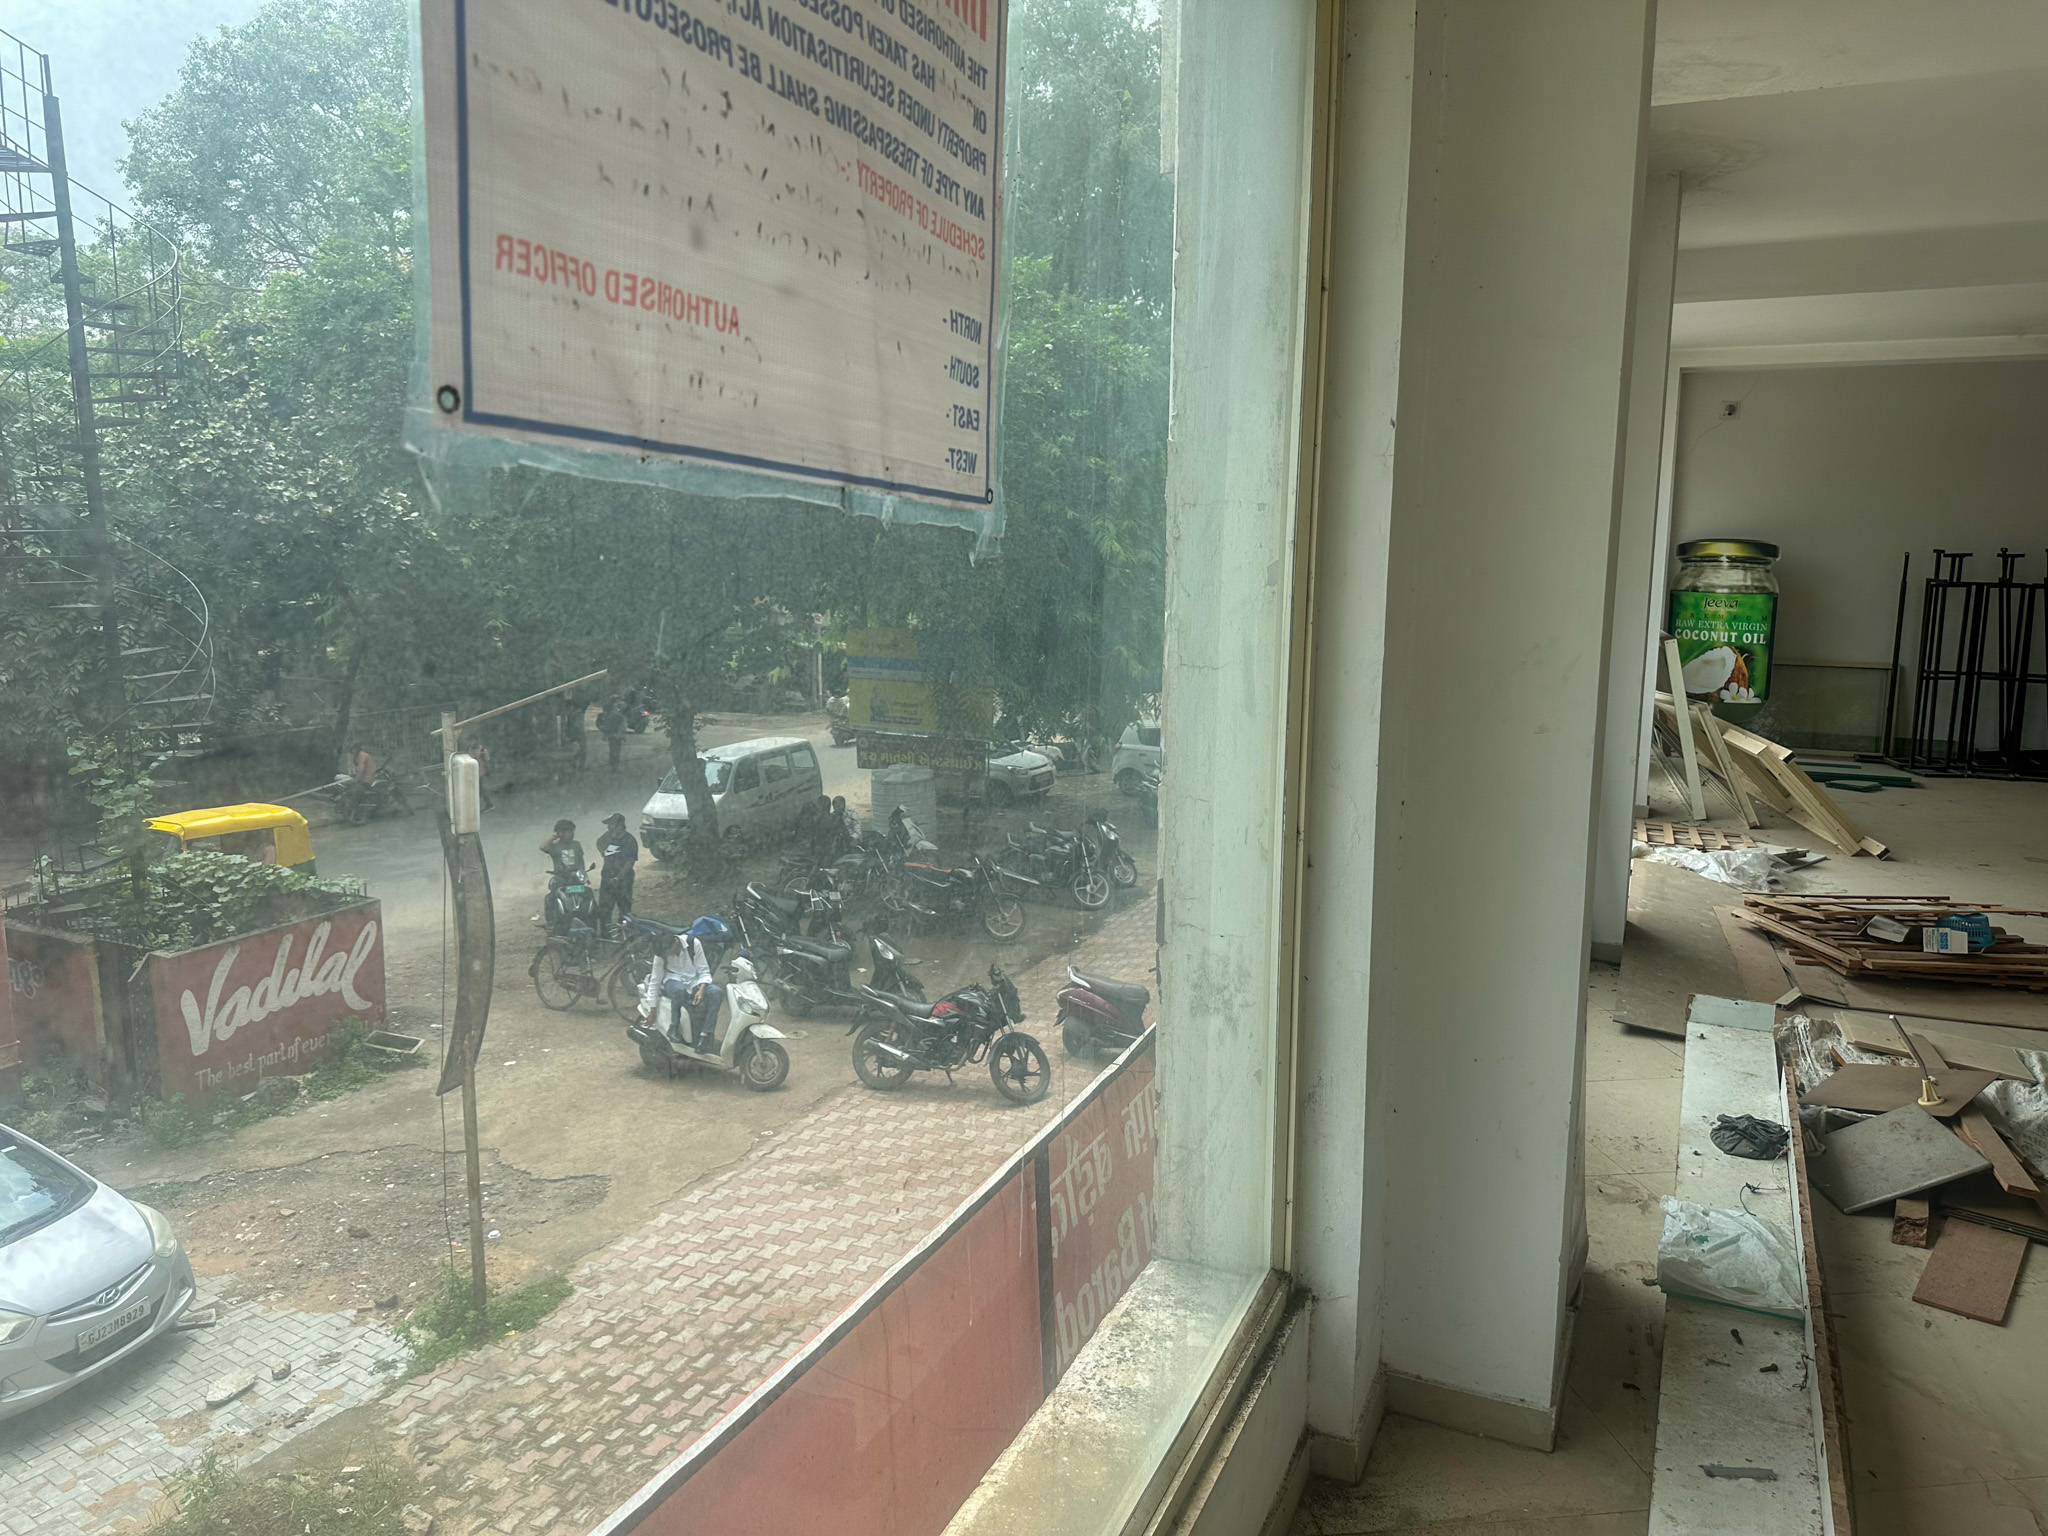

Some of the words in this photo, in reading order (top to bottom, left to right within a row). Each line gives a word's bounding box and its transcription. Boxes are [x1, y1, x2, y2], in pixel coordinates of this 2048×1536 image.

[1674, 628, 1738, 643] COCONUT
[1742, 632, 1767, 645] OIL
[1675, 618, 1696, 628] RAW
[1698, 620, 1729, 630] EXTRA
[1731, 621, 1768, 632] VIRGIN
[180, 920, 378, 1057] Vadilal
[194, 1067, 224, 1090] The
[227, 1052, 255, 1078] best
